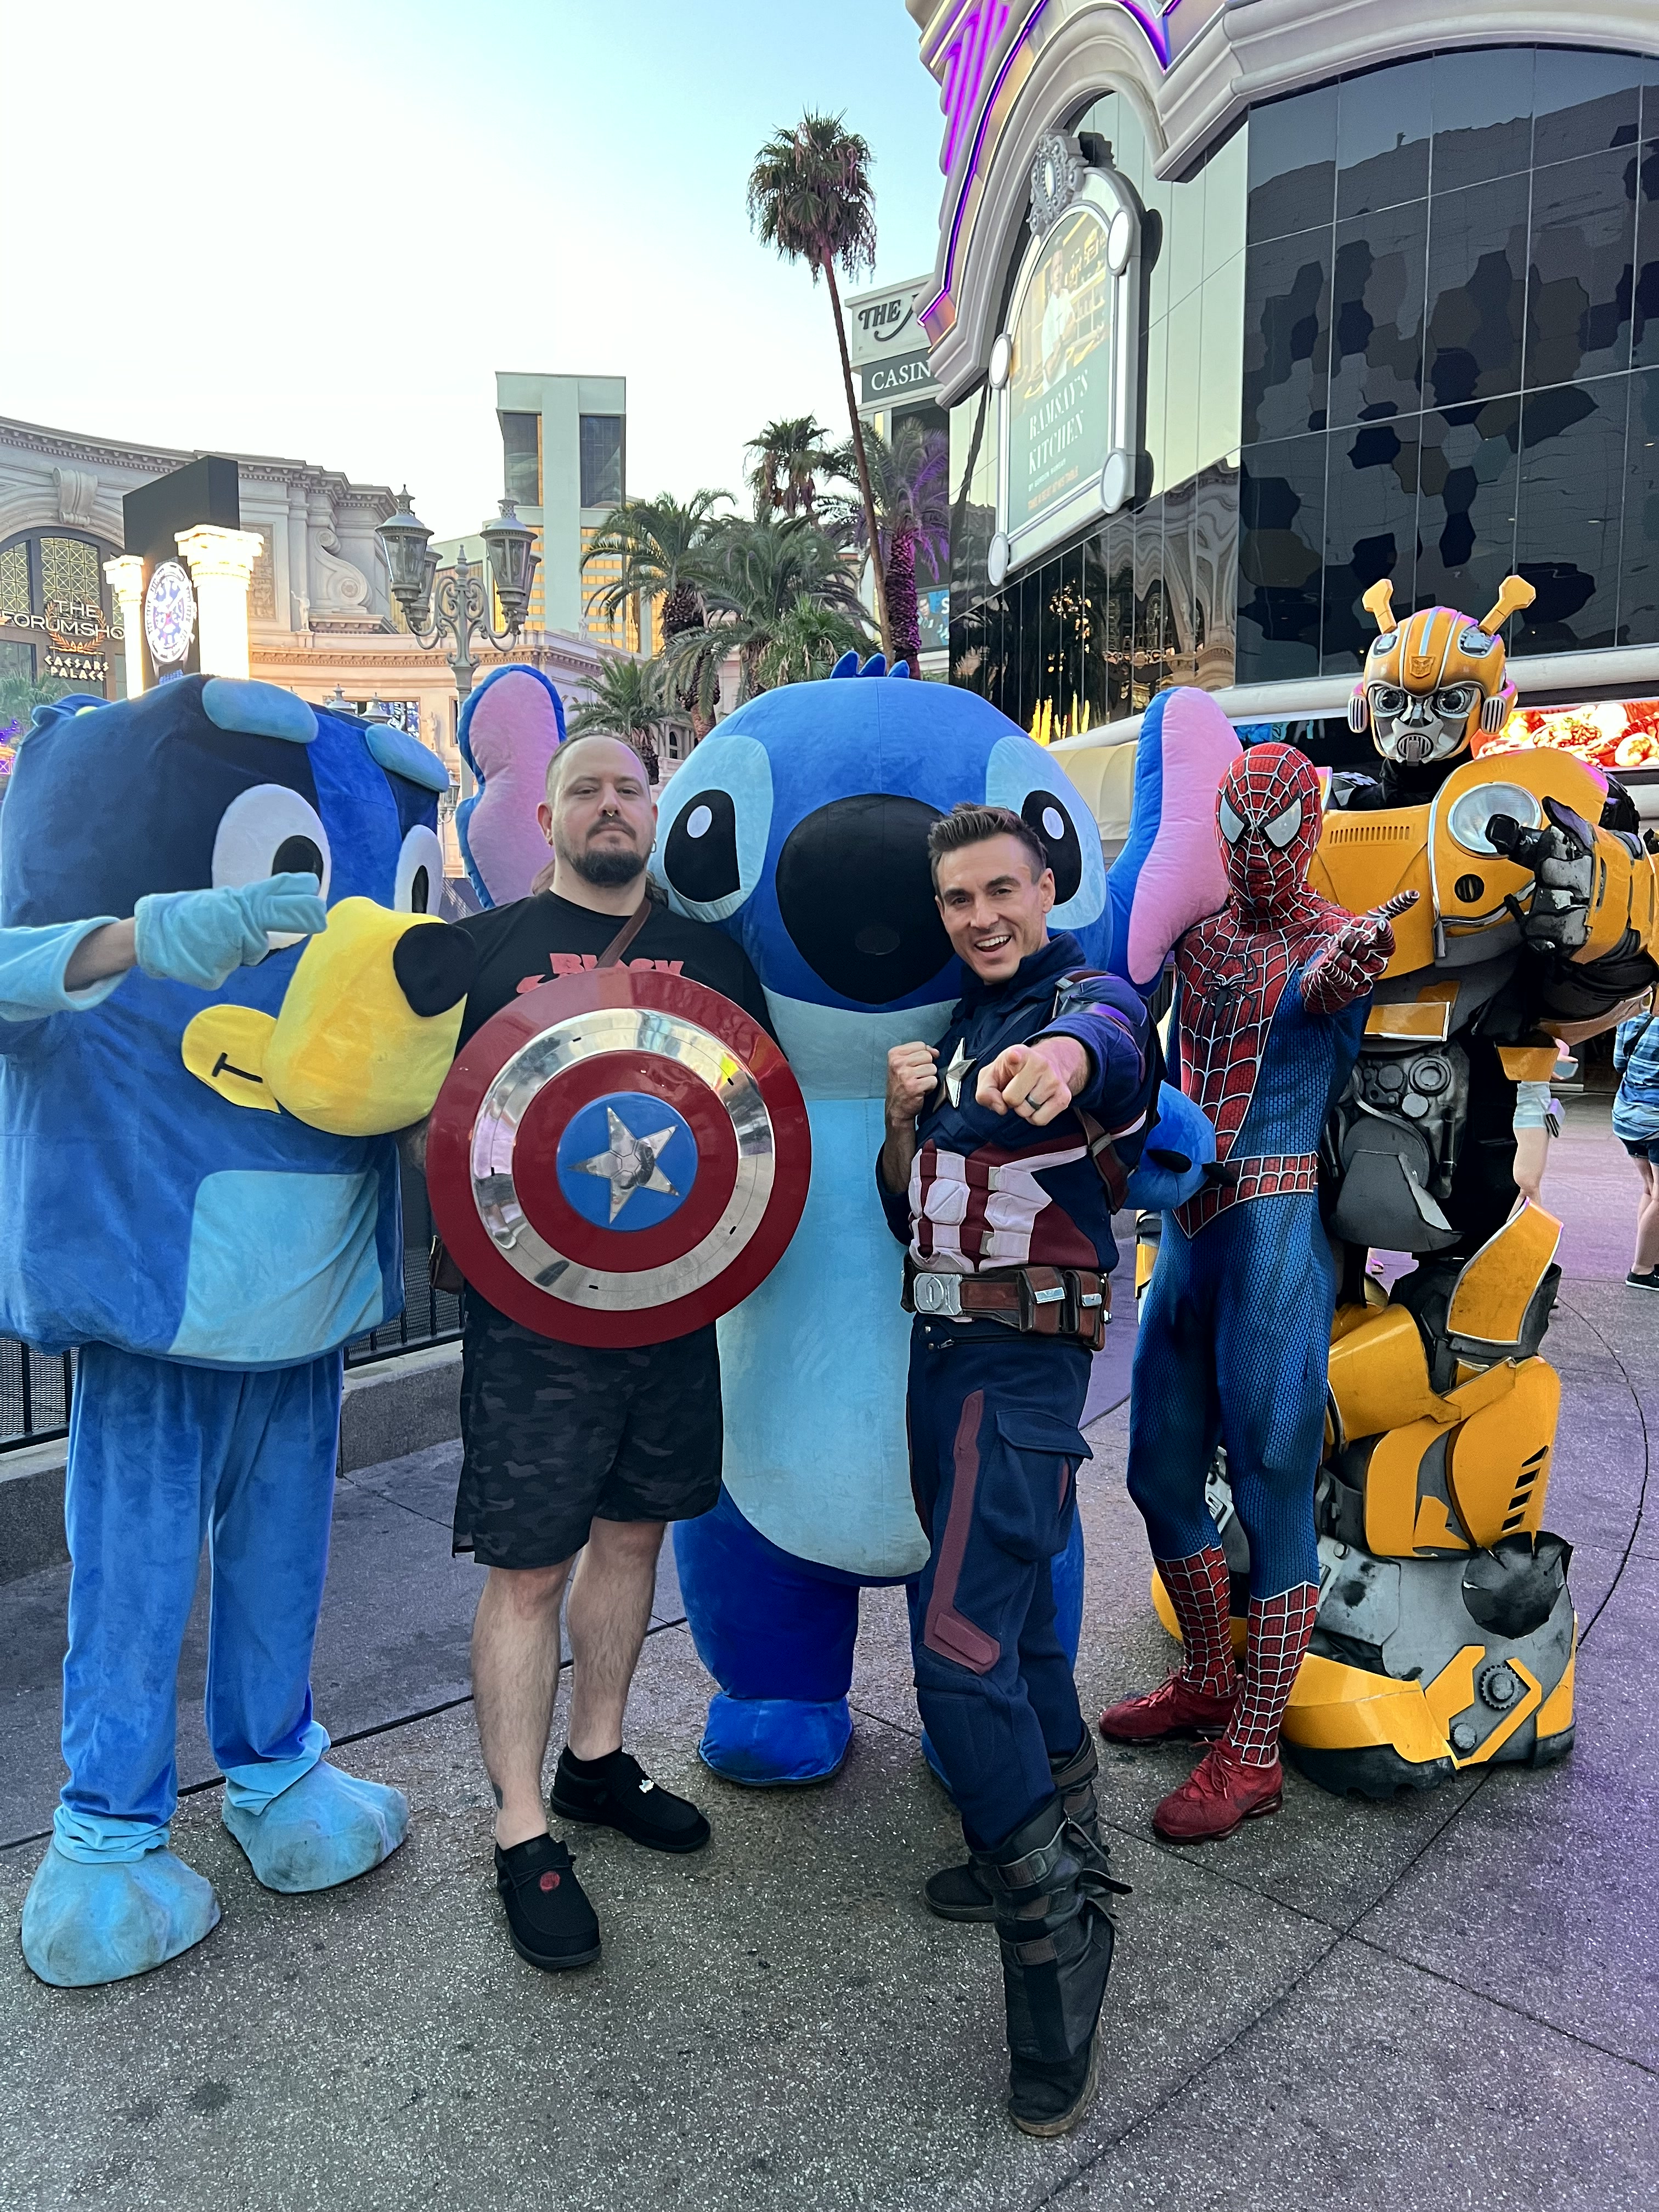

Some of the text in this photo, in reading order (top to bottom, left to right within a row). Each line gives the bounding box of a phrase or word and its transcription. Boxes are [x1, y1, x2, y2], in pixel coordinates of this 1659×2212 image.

[858, 300, 901, 330] THE
[1030, 369, 1088, 441] RAMSAY'S
[1029, 410, 1084, 475] KITCHEN
[53, 600, 100, 618] THE
[44, 655, 109, 671] CAESARS
[50, 666, 104, 681] PALACE
[550, 953, 684, 976] BLCK
